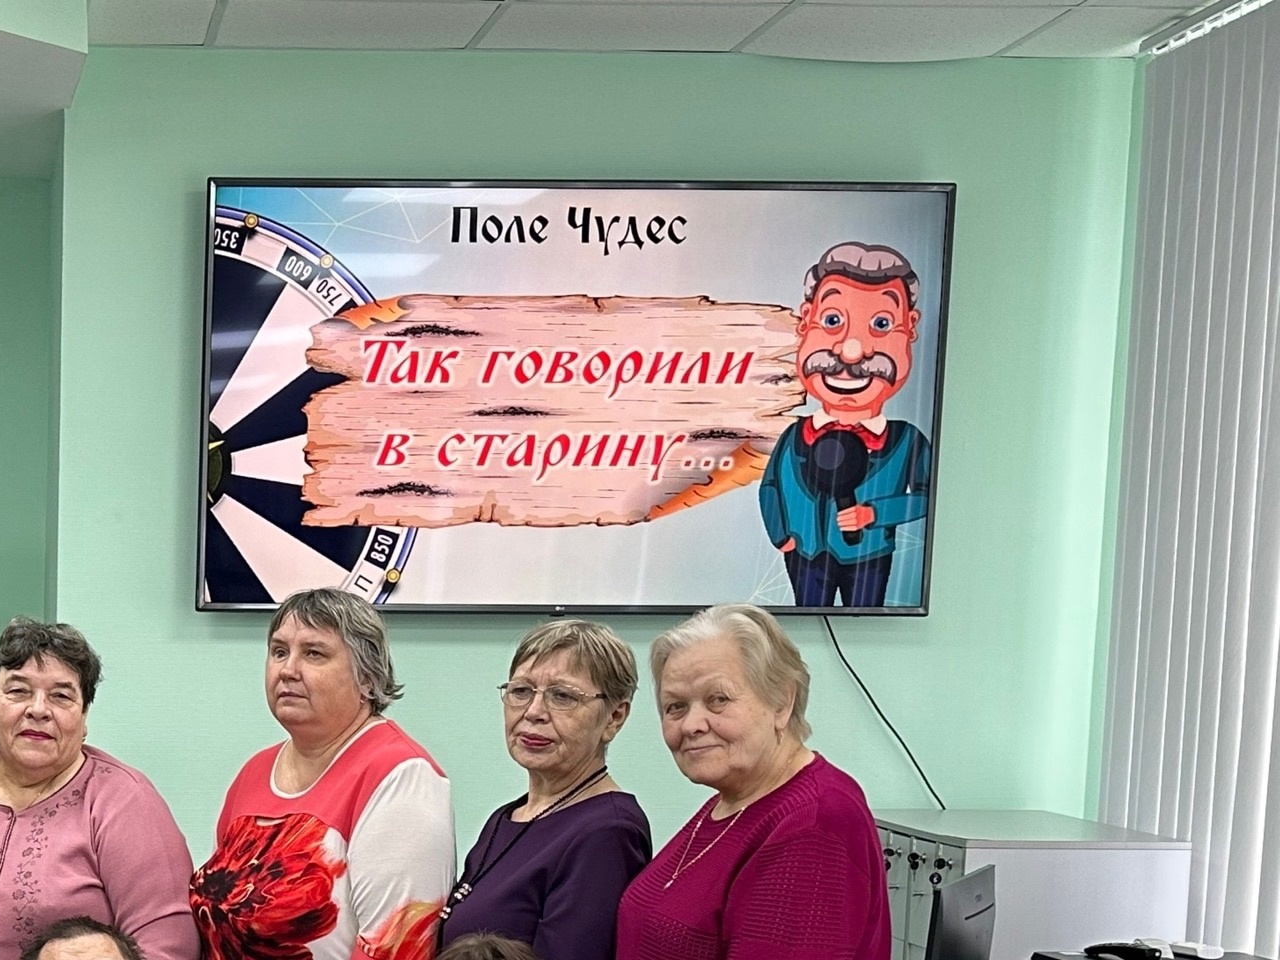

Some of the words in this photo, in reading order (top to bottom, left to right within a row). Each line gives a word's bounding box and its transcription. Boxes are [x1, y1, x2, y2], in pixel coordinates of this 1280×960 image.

[450, 205, 549, 244] Поле
[567, 206, 688, 256] Чудес
[284, 255, 313, 281] 600
[316, 279, 342, 307] 750
[363, 339, 459, 384] Так
[480, 350, 755, 399] говорили
[376, 433, 411, 467] в
[437, 433, 733, 482] старину...
[370, 534, 393, 563] 850
[353, 574, 374, 593] П
